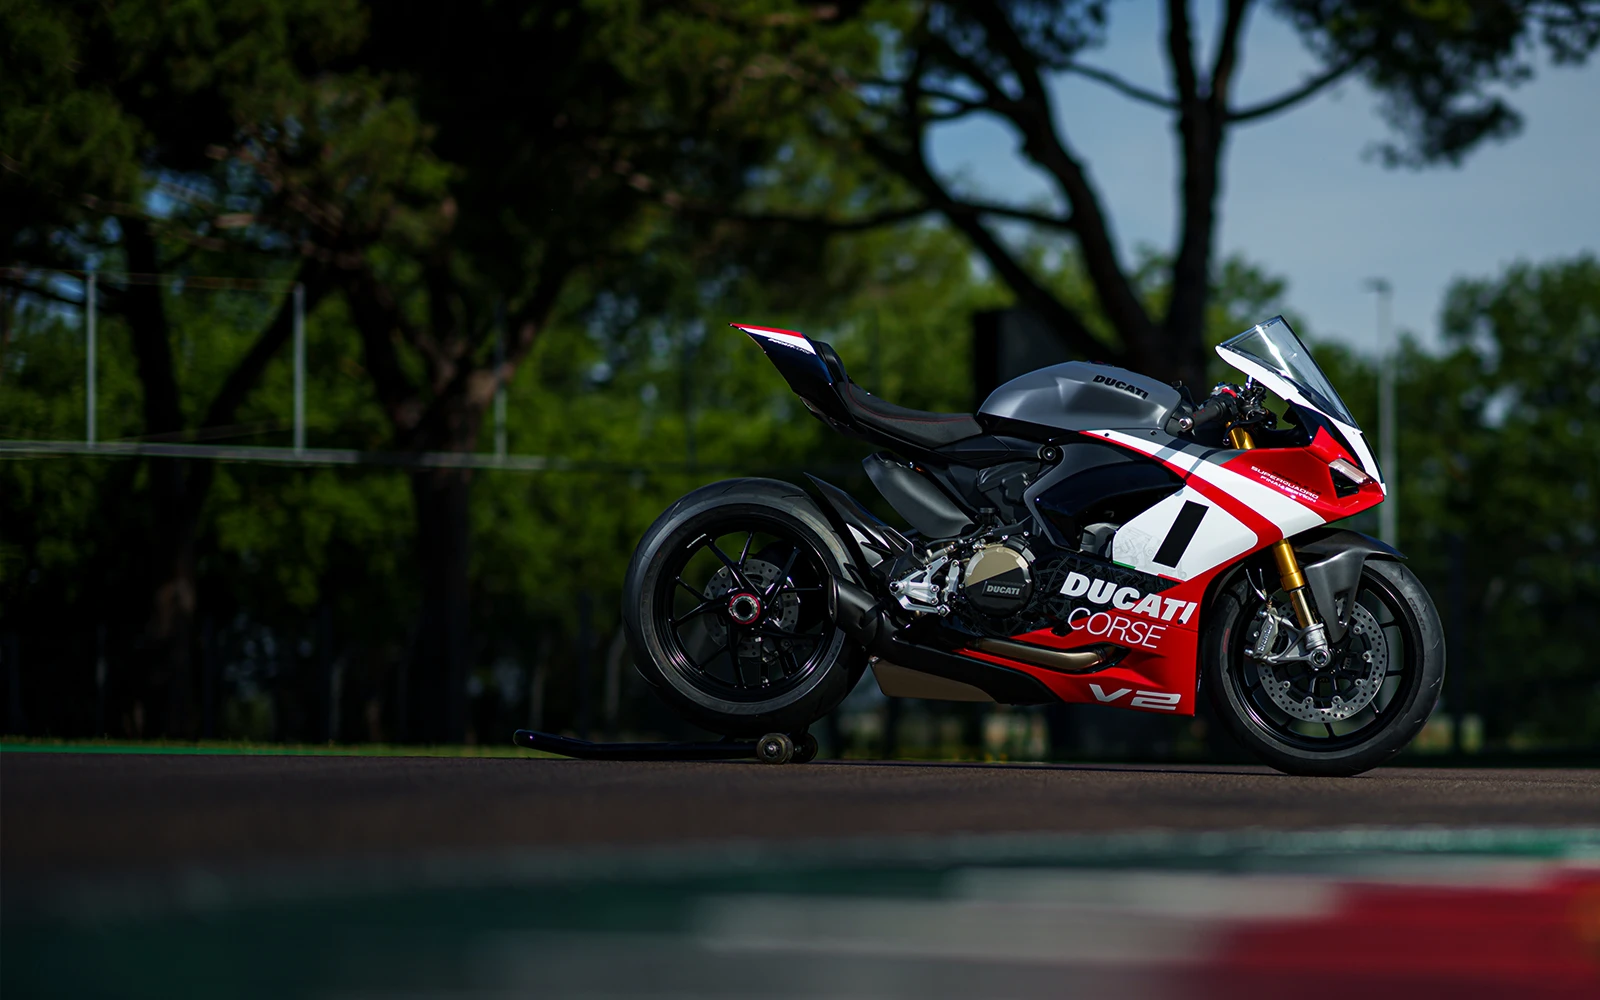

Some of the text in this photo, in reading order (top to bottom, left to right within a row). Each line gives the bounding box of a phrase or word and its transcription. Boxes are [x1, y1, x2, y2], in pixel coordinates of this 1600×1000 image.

[1092, 374, 1149, 400] DUCATI
[1251, 465, 1319, 500] SUPERQUADRO
[986, 584, 1021, 596] DUCATI
[1060, 571, 1197, 624] DUCATI
[1067, 607, 1166, 649] CORSE
[1088, 683, 1182, 711] V2
